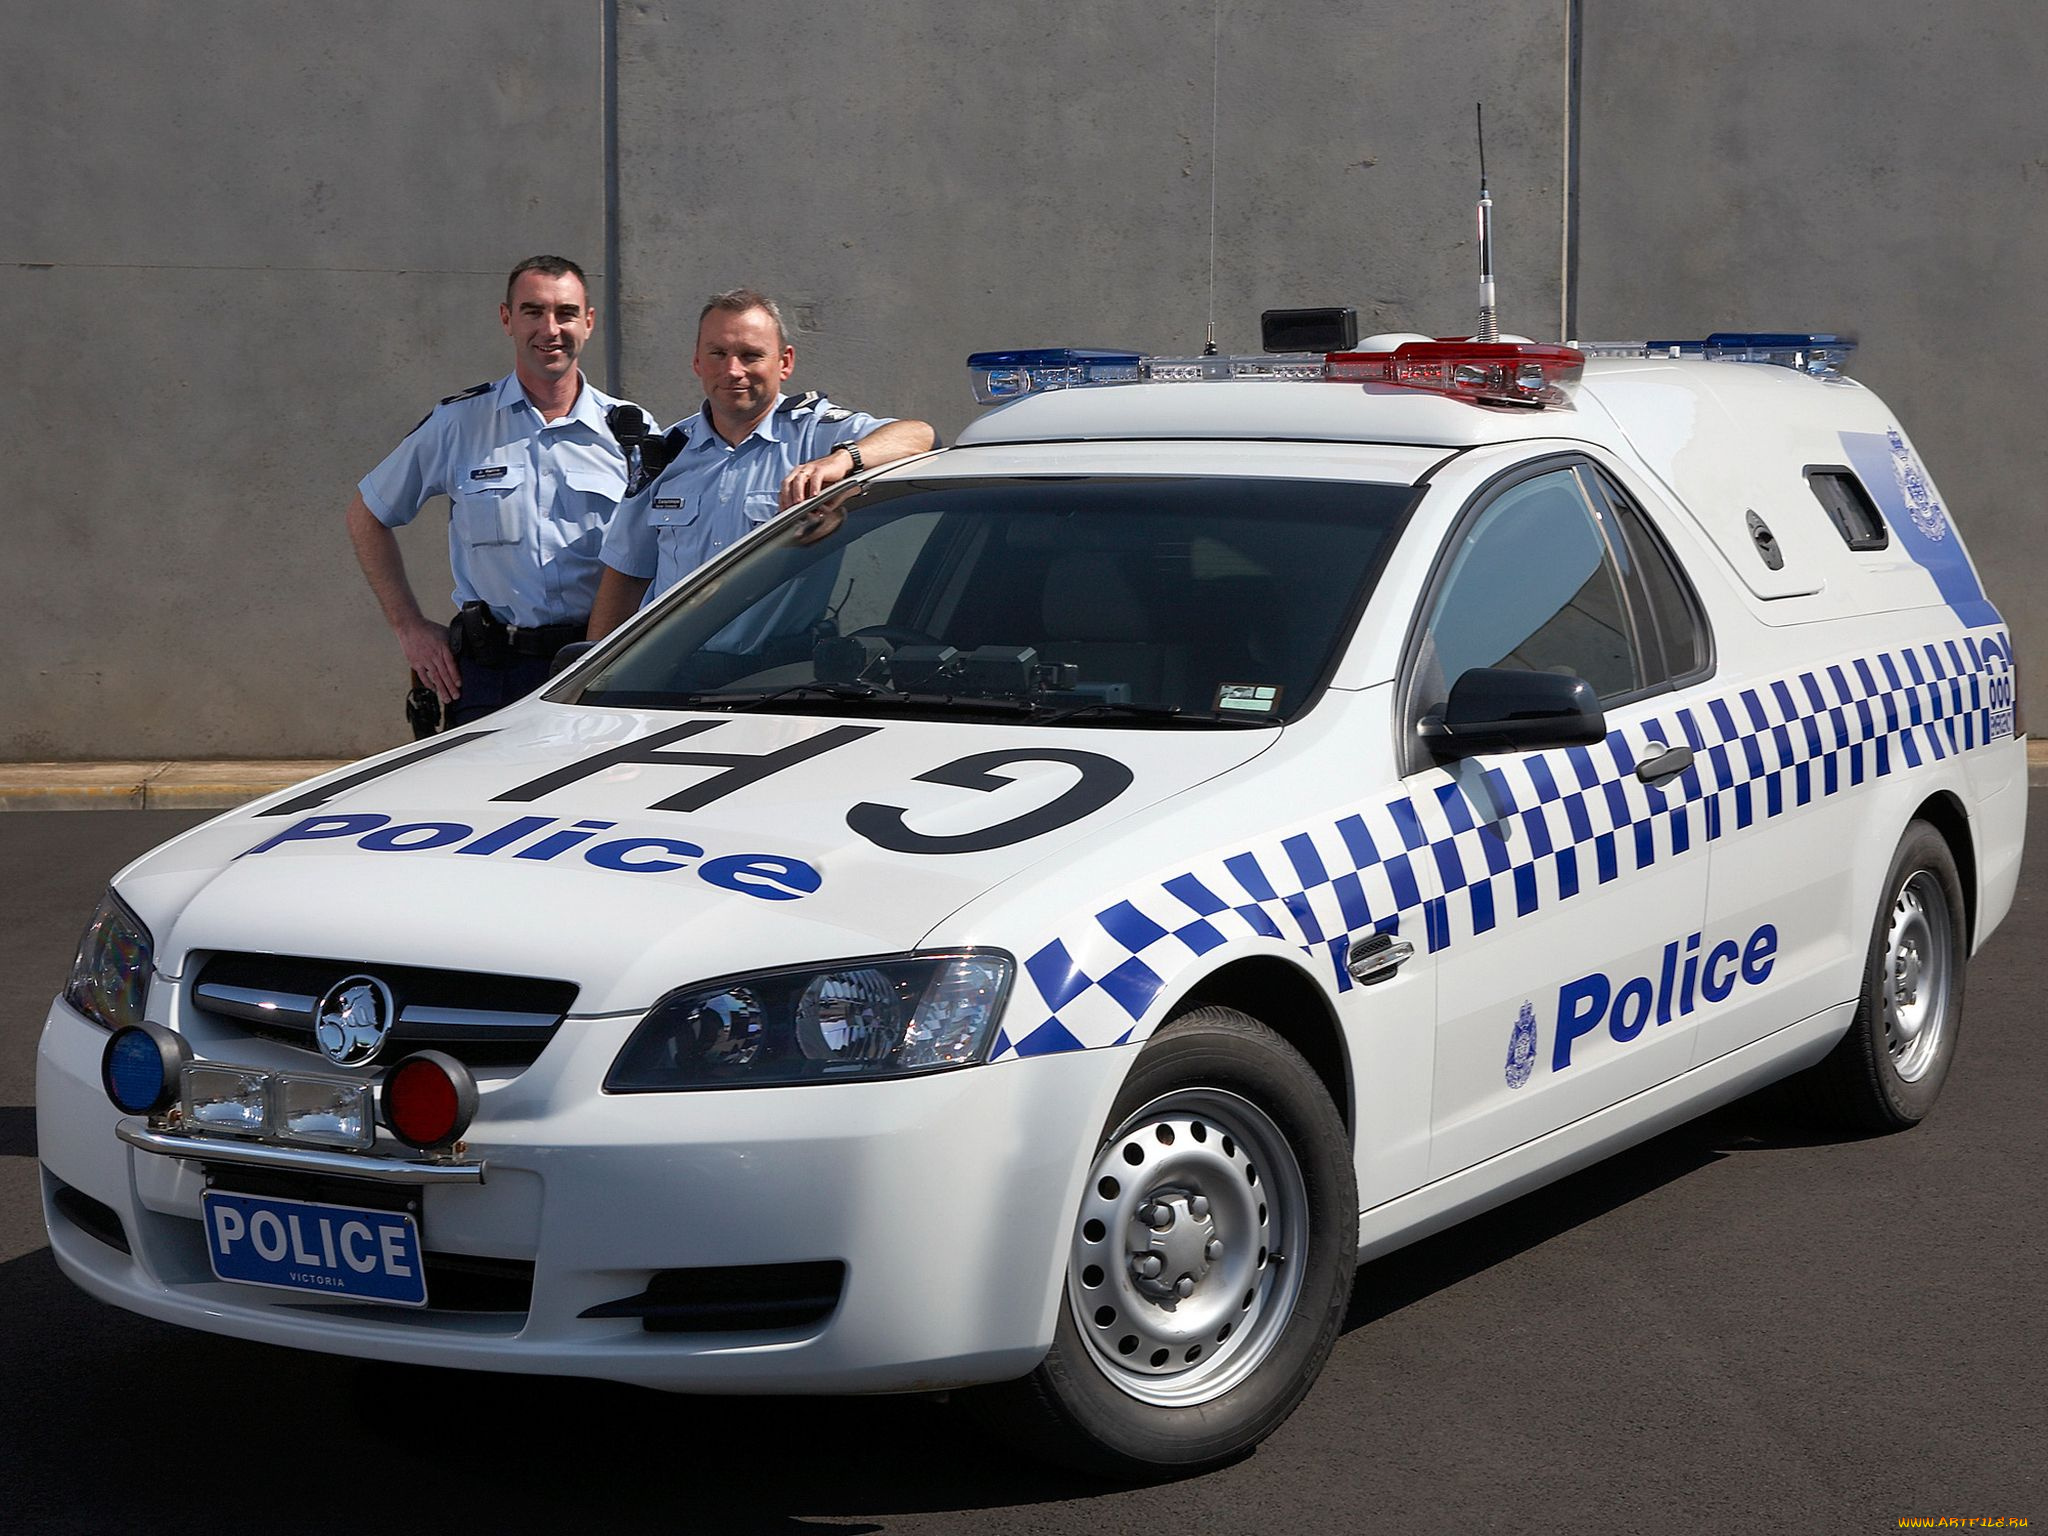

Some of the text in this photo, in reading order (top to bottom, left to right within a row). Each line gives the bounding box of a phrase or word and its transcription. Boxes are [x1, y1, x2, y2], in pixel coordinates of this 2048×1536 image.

[236, 813, 823, 901] Police
[1552, 923, 1778, 1073] Police
[213, 1205, 412, 1277] POLICE
[289, 1271, 345, 1288] VICTORIA
